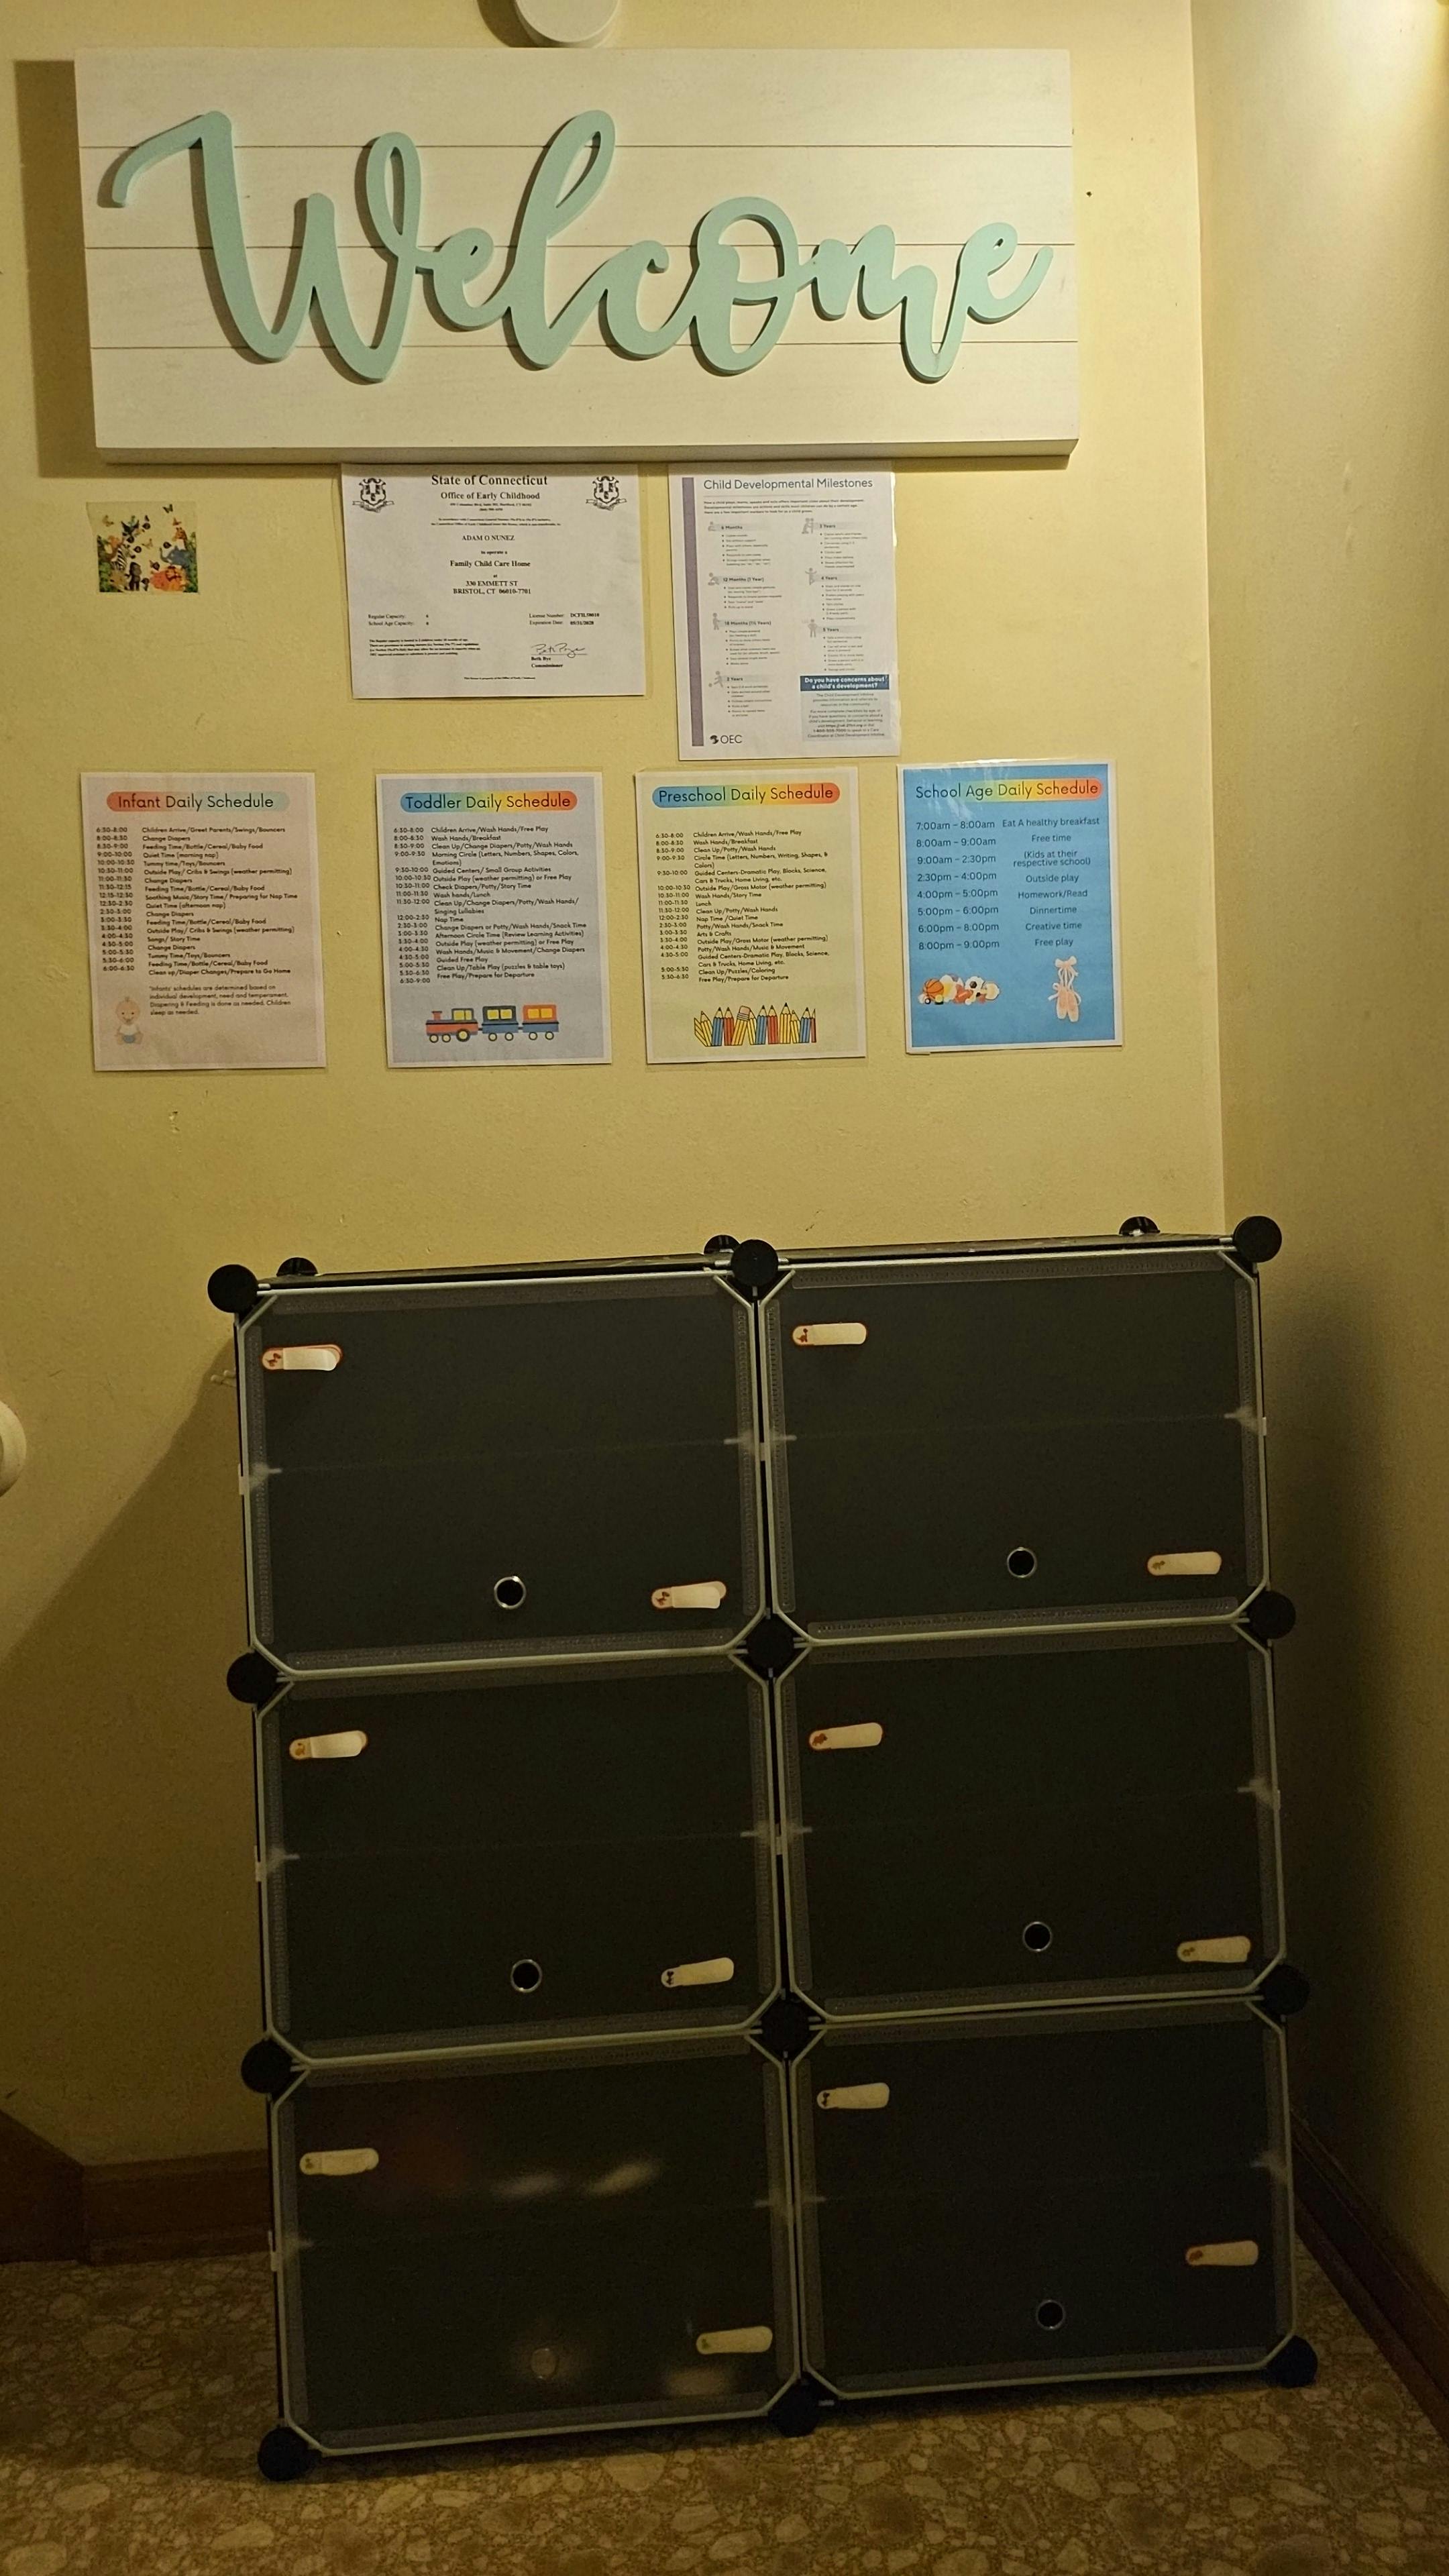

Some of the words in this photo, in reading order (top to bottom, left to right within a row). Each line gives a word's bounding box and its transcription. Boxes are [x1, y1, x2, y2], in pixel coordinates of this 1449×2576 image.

[107, 109, 1054, 382] Welcome
[431, 475, 461, 485] State
[464, 475, 477, 485] of
[479, 475, 547, 485] Connecticut
[704, 480, 731, 489] Child
[734, 479, 813, 491] Developmental
[817, 478, 872, 488] Milestones
[476, 492, 496, 500] Early
[720, 735, 742, 743] OEC
[659, 787, 725, 802] Preschool
[731, 786, 765, 804] Daily
[771, 784, 833, 800] Schedule
[916, 784, 961, 798] School
[965, 785, 992, 800] Age
[998, 782, 1032, 799] Daily
[1036, 780, 1097, 795] Schedule
[119, 794, 160, 808] Infant
[166, 794, 202, 812] Daily
[207, 794, 274, 808] Schedule
[405, 794, 462, 808] Toddler
[467, 794, 502, 812] Daily
[506, 794, 570, 808] Schedule
[916, 822, 950, 830] 7:00am
[960, 821, 994, 829] 8:00am
[1002, 819, 1016, 827] Eat
[1018, 818, 1024, 826] A
[1026, 818, 1057, 827] healthy
[1060, 816, 1099, 825] breakfast
[916, 839, 951, 847] 8:00am
[961, 837, 996, 846] 9:00am
[1032, 834, 1050, 842] Free
[1052, 833, 1071, 841] time
[1024, 850, 1045, 859] (Kids
[917, 855, 952, 864] 9:00am
[962, 855, 996, 865] 2:30pm
[1014, 858, 1057, 867] respective
[1060, 857, 1090, 865] school)
[917, 873, 951, 884] 2:30pm
[961, 871, 996, 881] 4:00pm
[1026, 873, 1059, 883] Outside
[1061, 873, 1079, 883] play
[917, 891, 953, 900] 4:00pm
[963, 888, 998, 898] 5:00pm
[1018, 890, 1087, 899] Homework/Read
[918, 907, 953, 918] 5:00pm
[963, 905, 998, 915] 6:00pm
[1030, 906, 1077, 914] Dinnertime
[918, 924, 953, 934] 6:00pm
[964, 923, 999, 932] 8:00pm
[1025, 922, 1061, 930] Creative
[1063, 921, 1081, 929] time
[918, 941, 954, 951] 8:00pm
[964, 941, 1000, 949] 9:00pm
[1055, 936, 1073, 947] play
